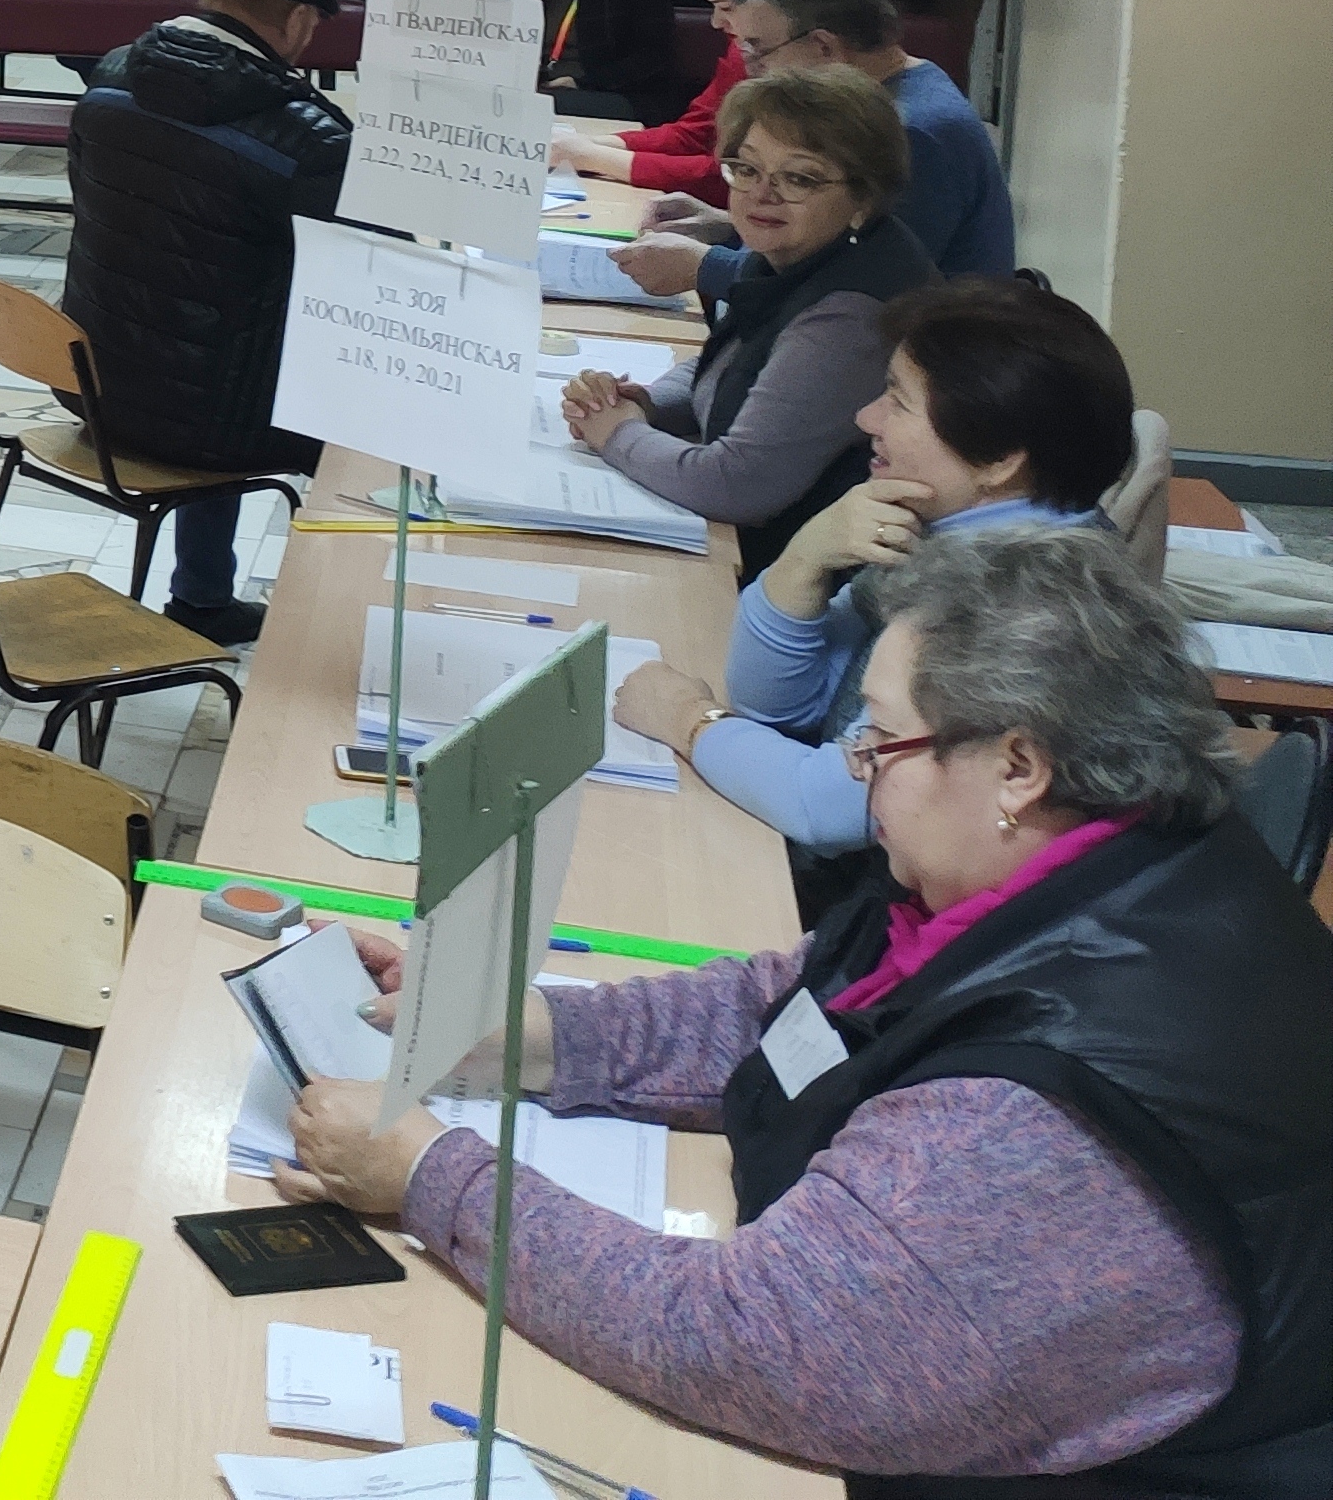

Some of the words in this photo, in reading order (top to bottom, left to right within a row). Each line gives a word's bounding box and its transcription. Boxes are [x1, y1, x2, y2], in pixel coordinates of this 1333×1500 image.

[368, 12, 390, 28] ул.
[395, 11, 539, 45] ГВАРДЕЙСКАЯ
[356, 112, 381, 130] ул.
[387, 112, 547, 163] ГВАРДЕЙСКАЯ
[360, 145, 405, 171] д.22,
[410, 152, 452, 181] 22А,
[459, 163, 486, 189] 24,
[492, 170, 533, 197] 24А
[407, 288, 447, 316] ЗОЯ
[301, 295, 522, 374] КОСМОДЕМЬЯНСКАЯ
[336, 346, 379, 374] д.18,
[385, 354, 411, 383] 19,
